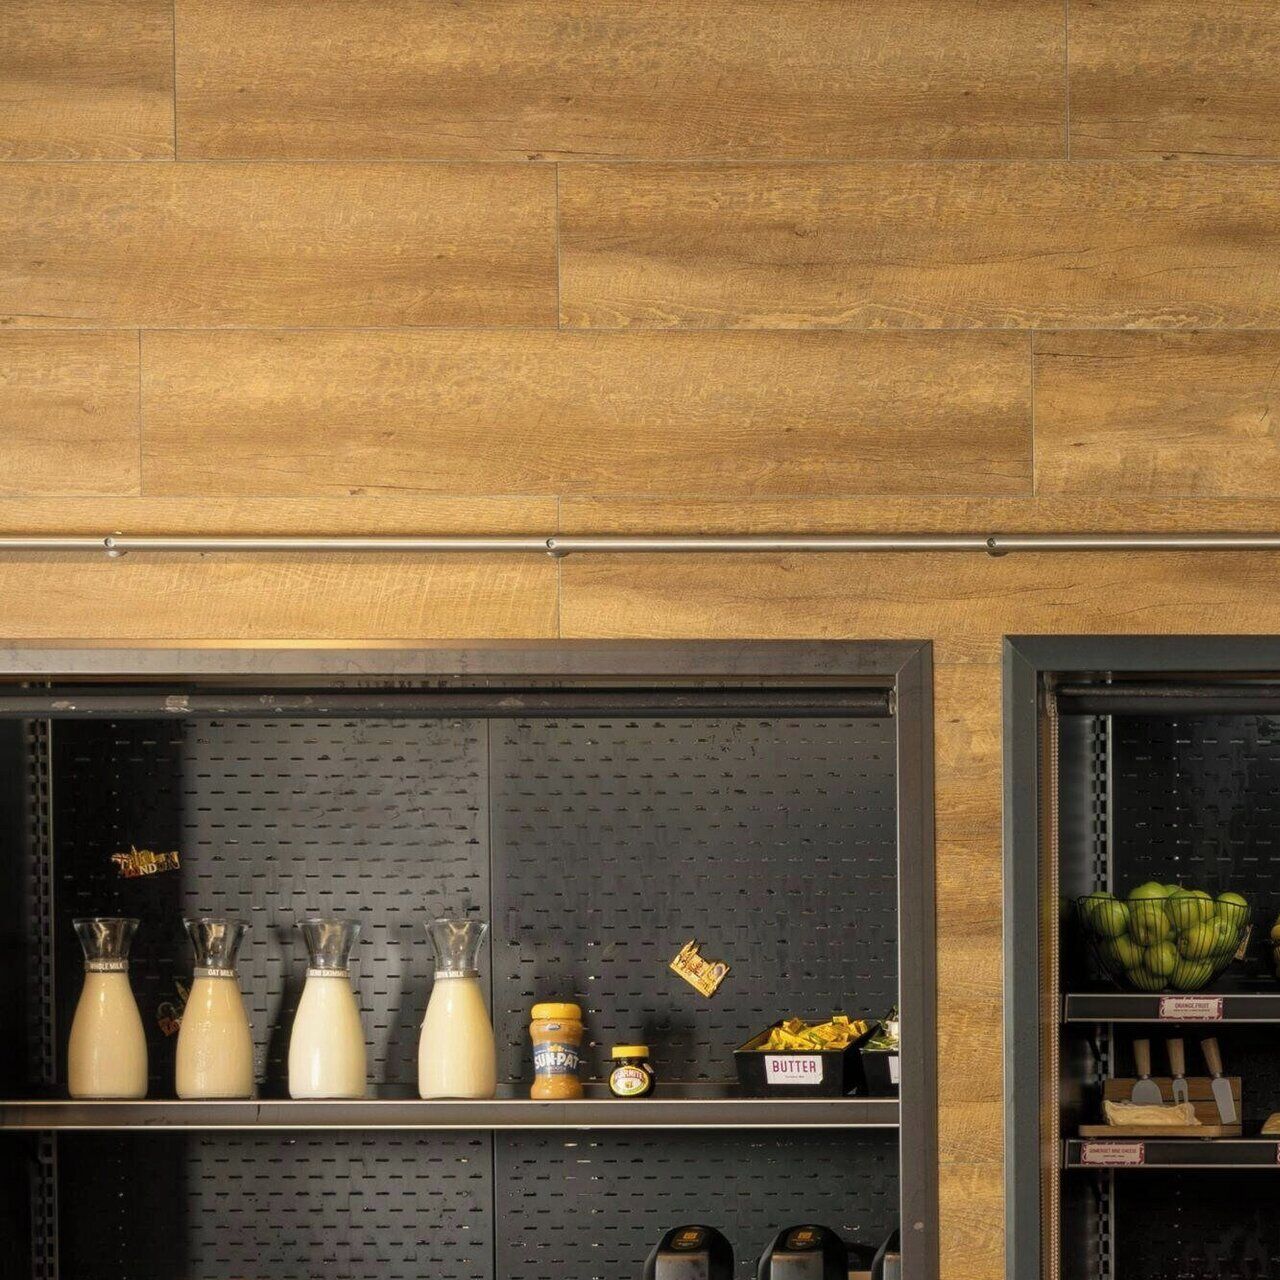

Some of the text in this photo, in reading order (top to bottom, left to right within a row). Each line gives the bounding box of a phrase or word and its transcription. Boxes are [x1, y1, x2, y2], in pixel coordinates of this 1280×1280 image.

[109, 962, 124, 970] MILK
[207, 968, 234, 977] OAT MILK
[534, 1052, 579, 1069] SUN-PAT
[772, 1060, 816, 1073] BUTTER
